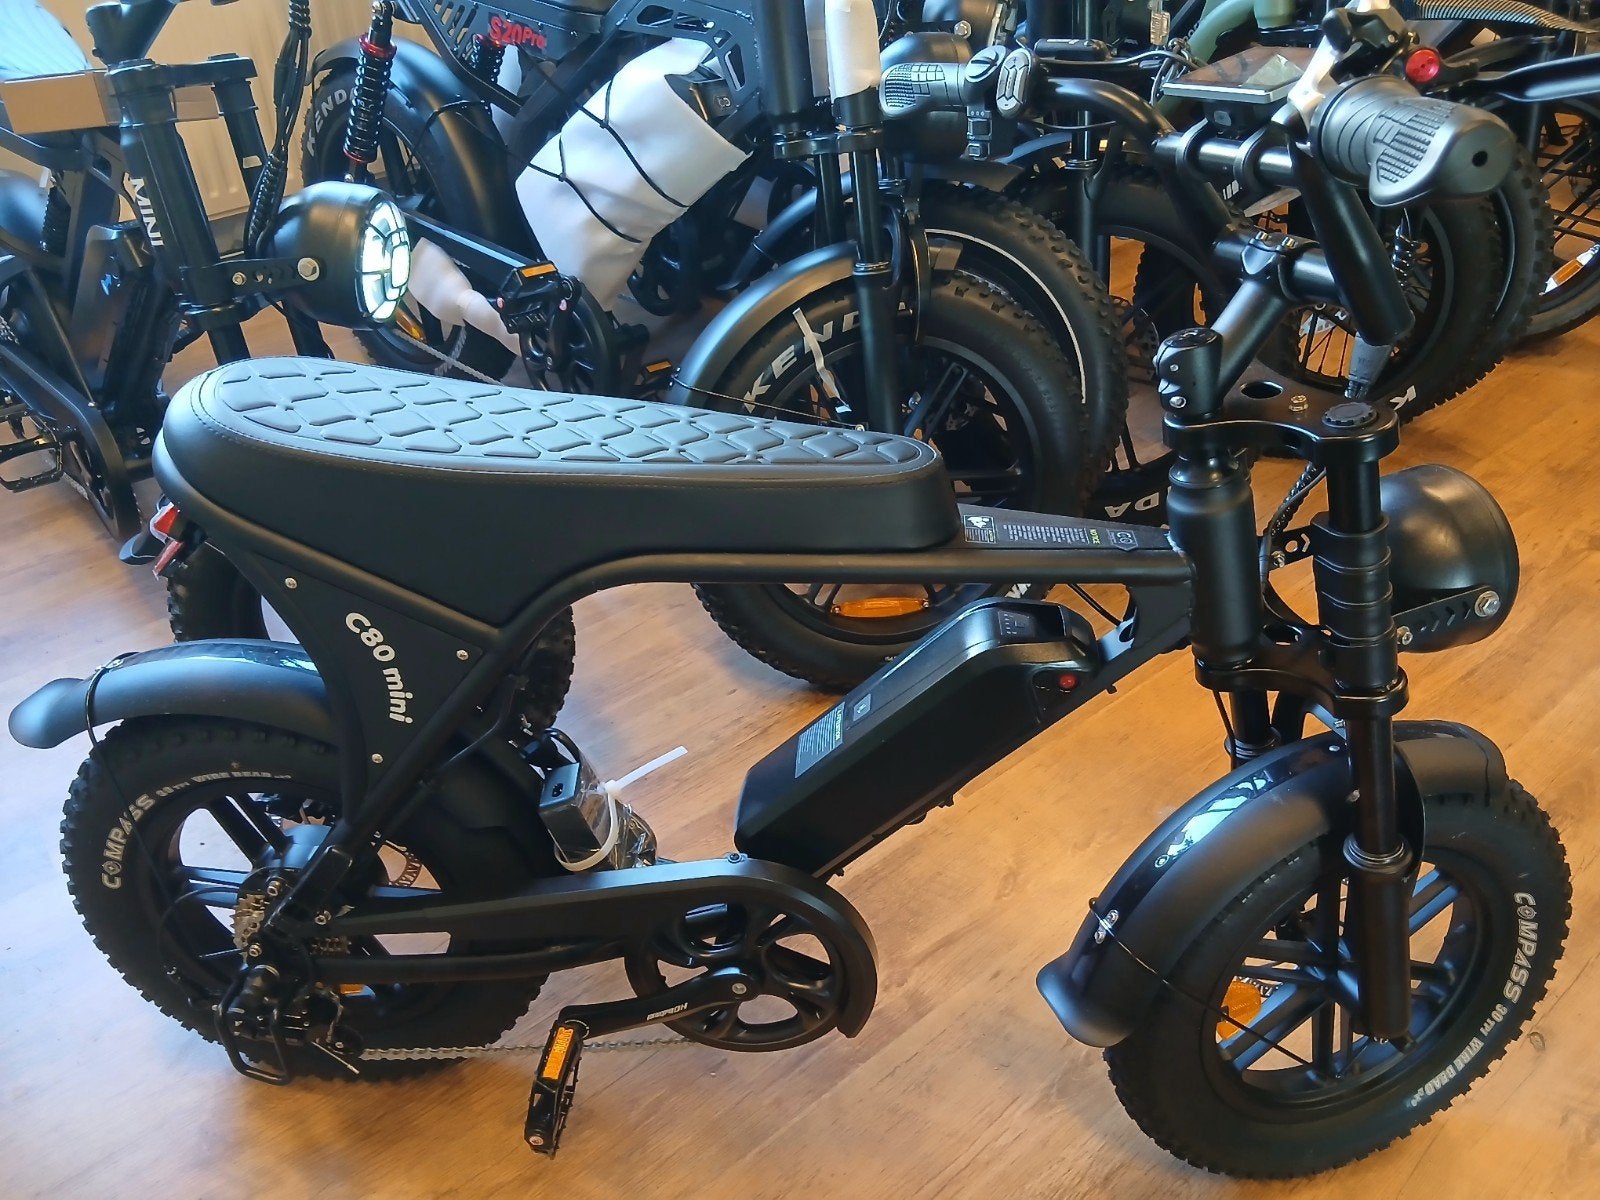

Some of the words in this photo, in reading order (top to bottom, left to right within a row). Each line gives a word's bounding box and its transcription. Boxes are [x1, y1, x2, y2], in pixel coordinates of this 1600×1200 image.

[489, 15, 547, 49] S20Pro
[306, 86, 357, 157] KEND
[128, 177, 164, 247] MINI
[743, 310, 861, 414] KEND
[345, 612, 396, 662] C80
[382, 667, 414, 724] mini
[101, 793, 156, 890] COMPASS
[1502, 892, 1538, 1004] COMPASS
[1424, 1064, 1457, 1095] BEAD
[1453, 1037, 1485, 1071] WIRE
